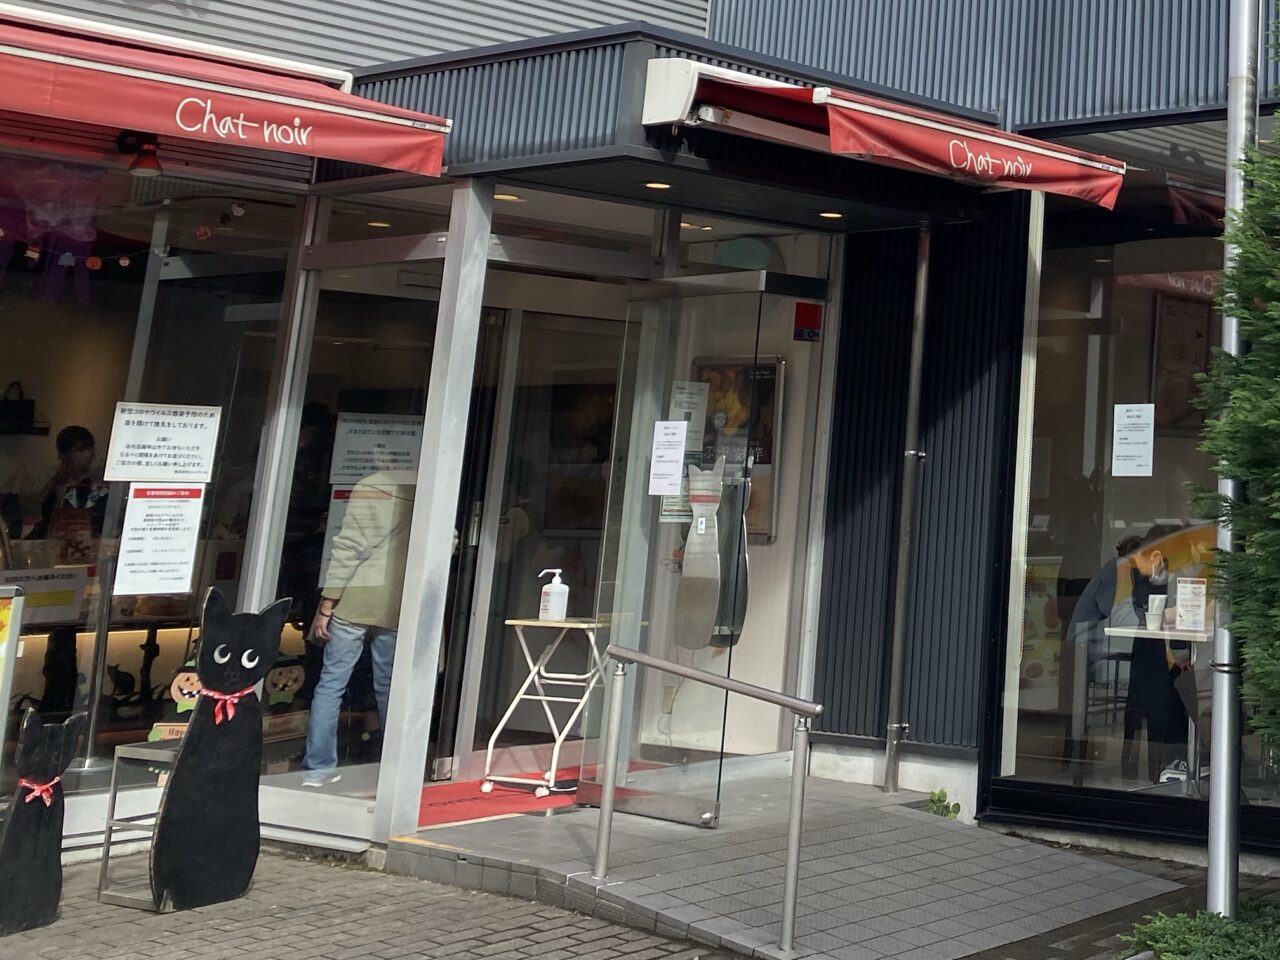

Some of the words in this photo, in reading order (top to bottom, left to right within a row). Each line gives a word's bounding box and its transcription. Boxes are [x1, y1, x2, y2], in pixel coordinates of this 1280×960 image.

[175, 97, 258, 141] Chat
[263, 117, 313, 145] noir
[949, 139, 1001, 176] Chat
[1002, 155, 1033, 178] noir
